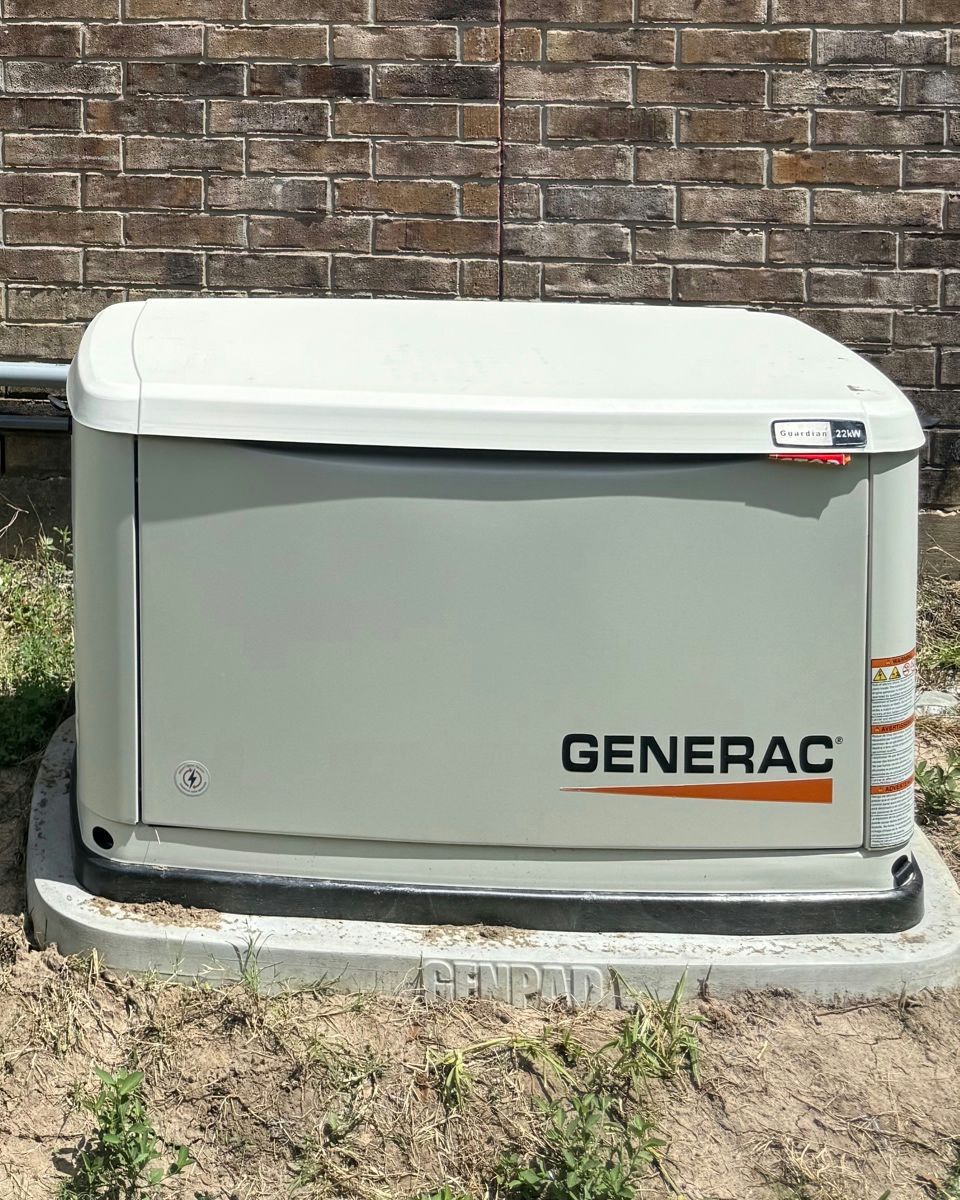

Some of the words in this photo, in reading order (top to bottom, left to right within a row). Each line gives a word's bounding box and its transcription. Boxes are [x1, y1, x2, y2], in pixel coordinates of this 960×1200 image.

[835, 429, 861, 438] 22kW
[562, 733, 833, 773] GENERAC
[423, 959, 604, 1008] GENPAD
